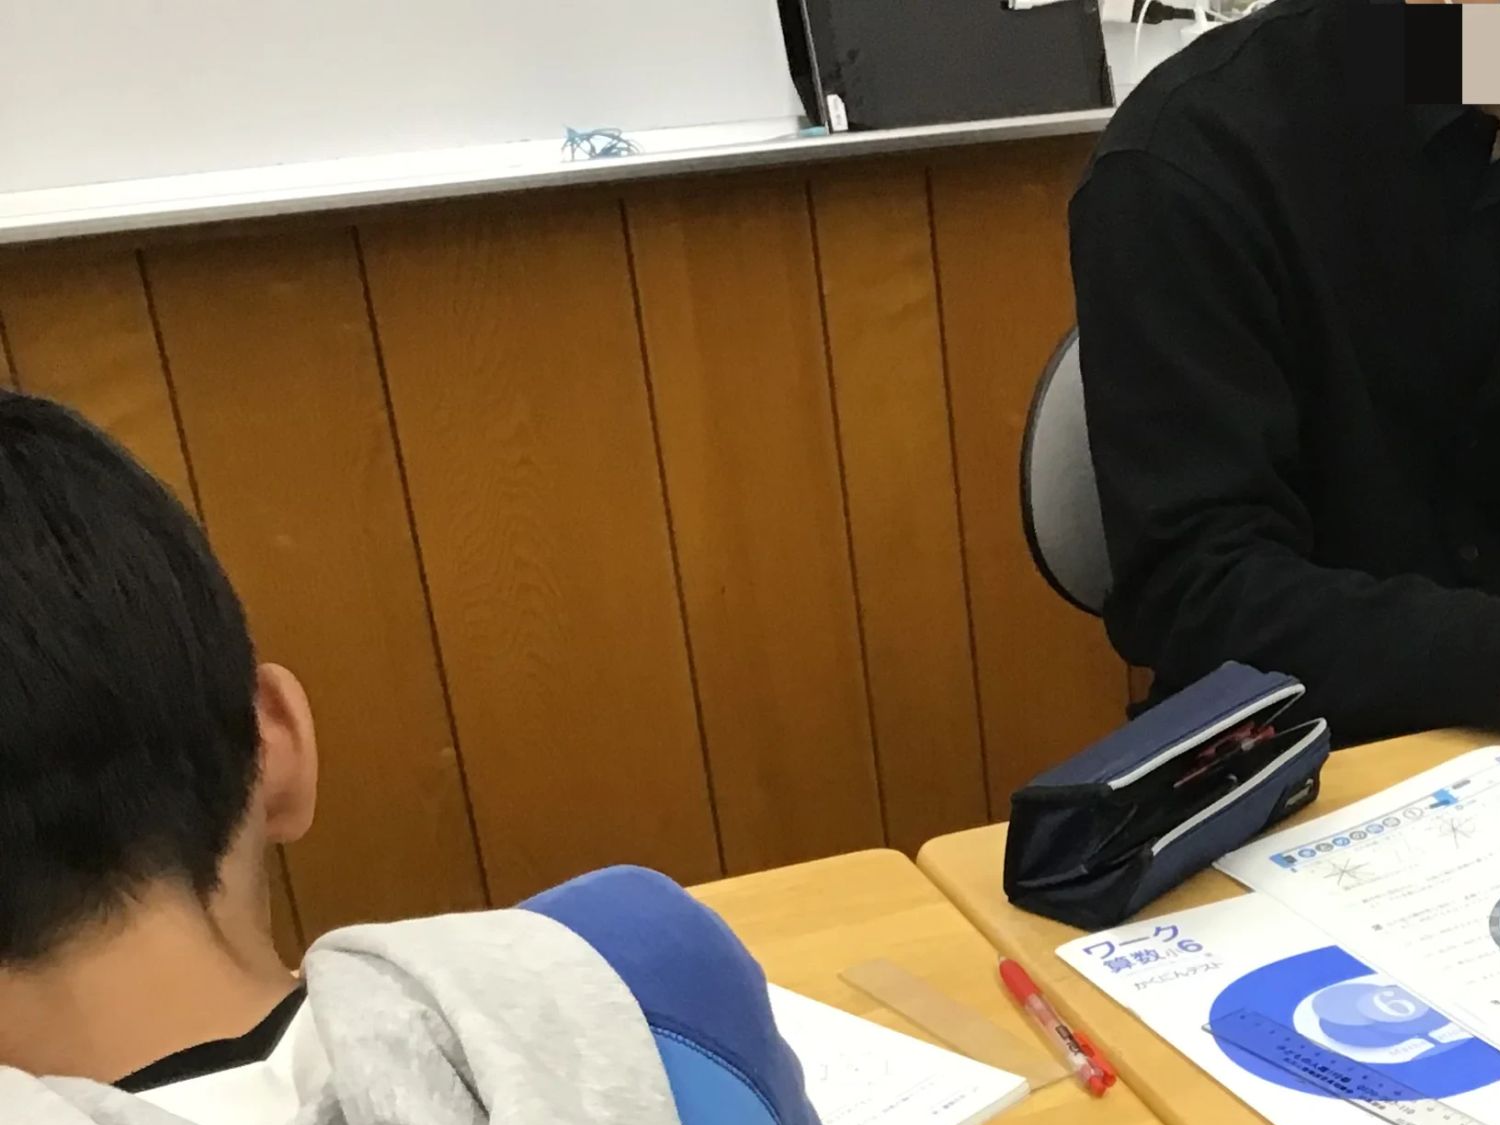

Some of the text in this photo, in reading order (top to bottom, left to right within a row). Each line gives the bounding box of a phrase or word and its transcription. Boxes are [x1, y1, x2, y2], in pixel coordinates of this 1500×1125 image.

[1082, 924, 1180, 960] ワーク
[1372, 989, 1416, 1018] 6
